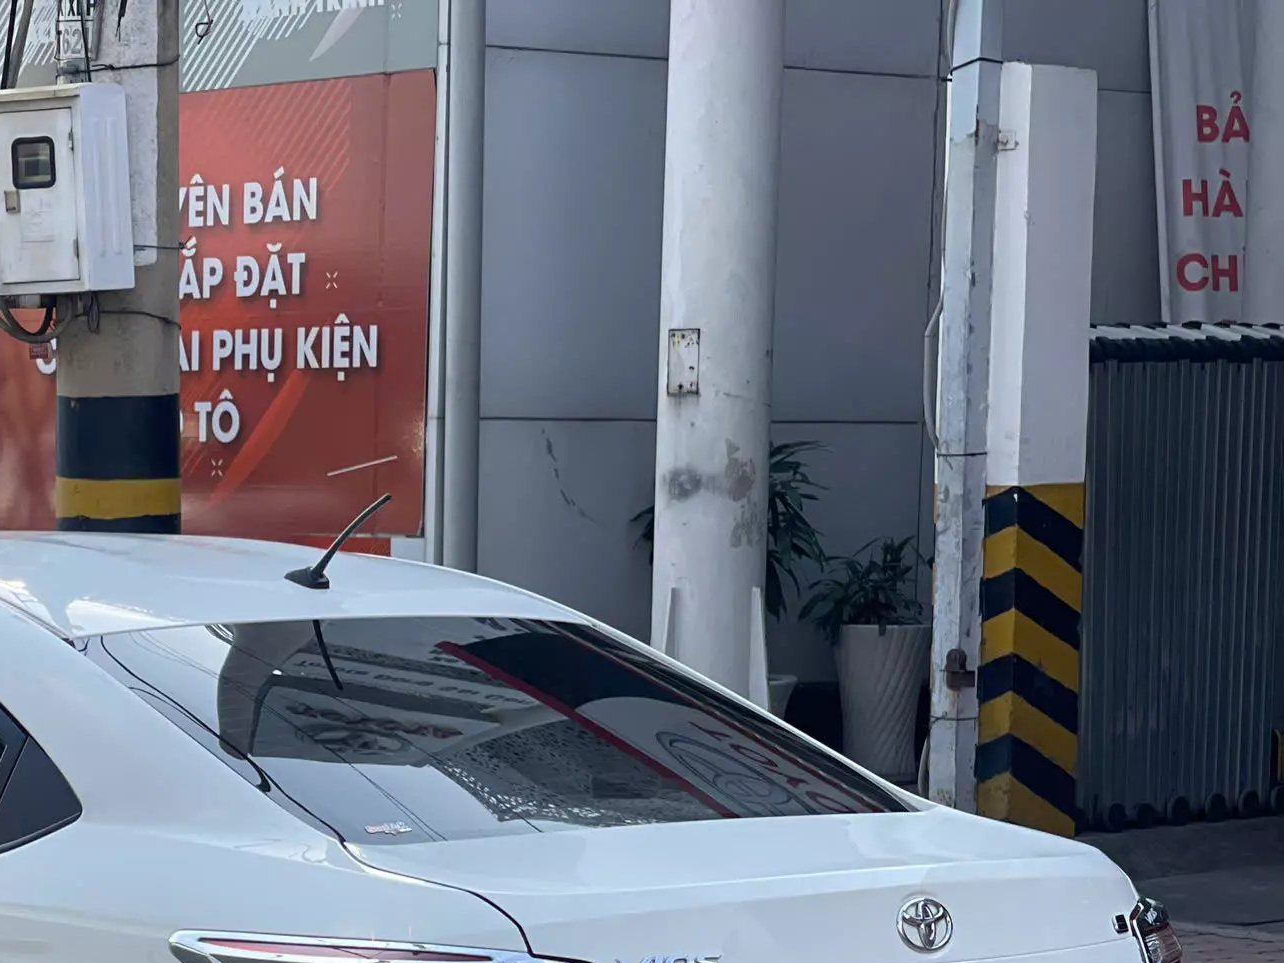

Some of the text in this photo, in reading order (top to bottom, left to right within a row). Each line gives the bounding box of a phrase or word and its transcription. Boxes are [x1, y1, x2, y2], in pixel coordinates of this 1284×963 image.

[243, 166, 317, 224] BÁN
[178, 236, 306, 309] ẮP ĐẶT
[212, 327, 283, 382] PHỤ
[297, 313, 378, 381] KIỆN
[194, 388, 240, 443] TÔ
